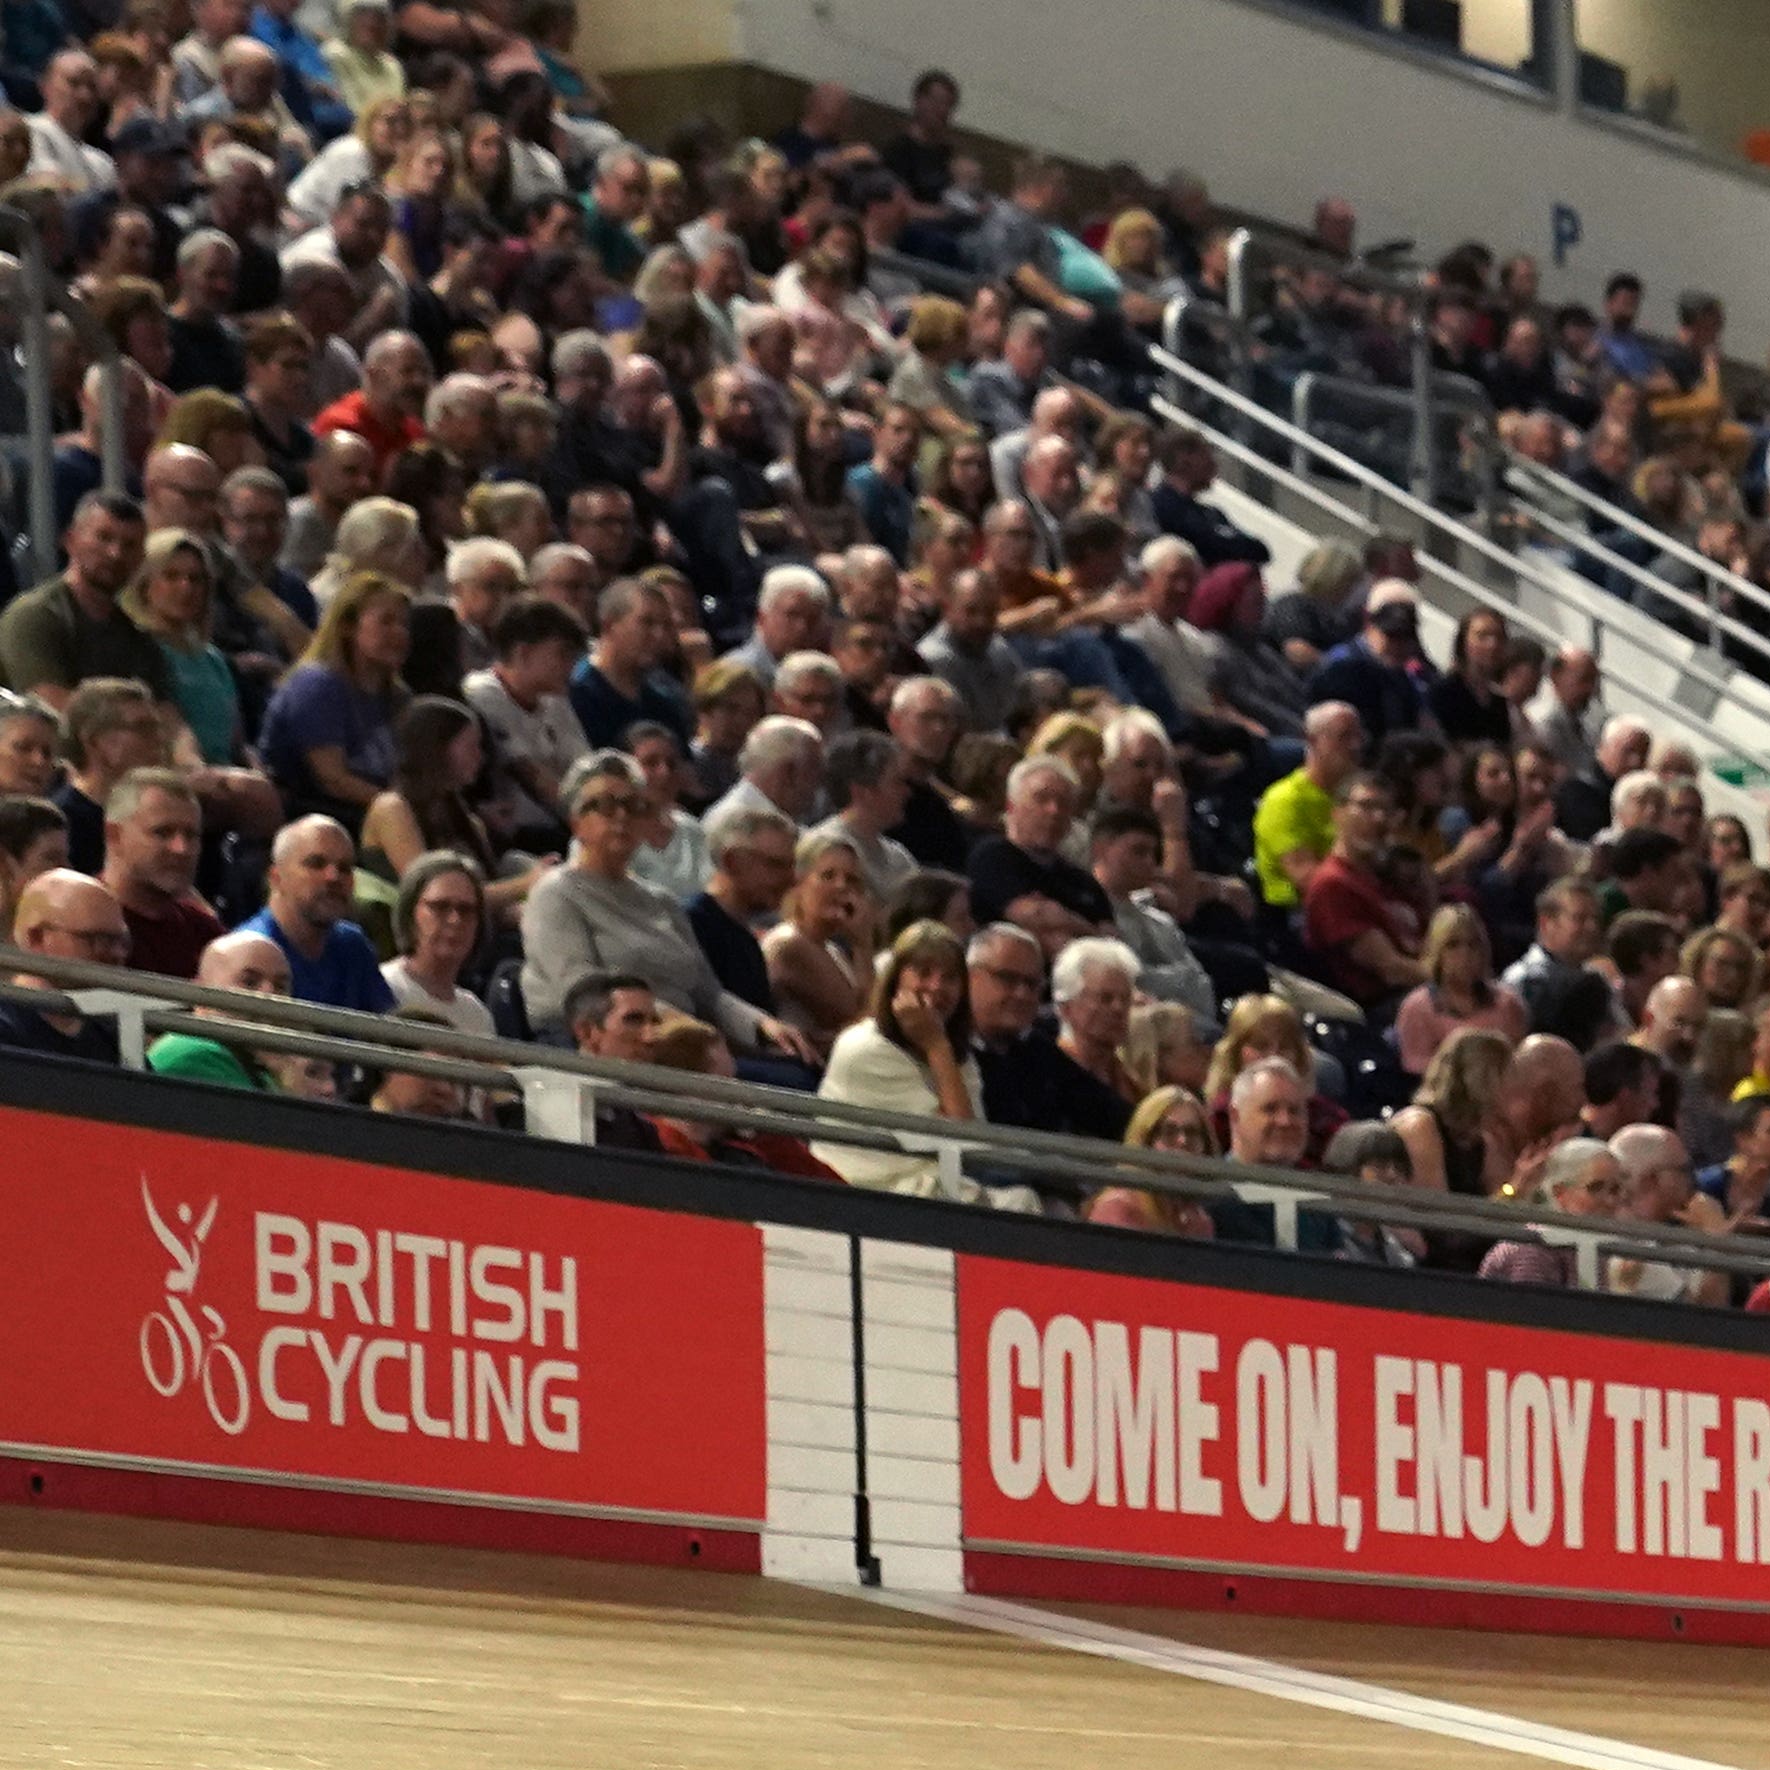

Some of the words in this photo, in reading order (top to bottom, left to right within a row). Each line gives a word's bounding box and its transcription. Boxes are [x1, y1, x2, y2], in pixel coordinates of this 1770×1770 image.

[1550, 204, 1581, 266] P
[255, 1210, 579, 1352] BRITISH
[258, 1325, 580, 1454] CYCLING
[987, 1307, 1223, 1517] COME
[1235, 1337, 1364, 1554] ON,
[1374, 1354, 1593, 1552] ENJOY
[1604, 1382, 1722, 1559] THE
